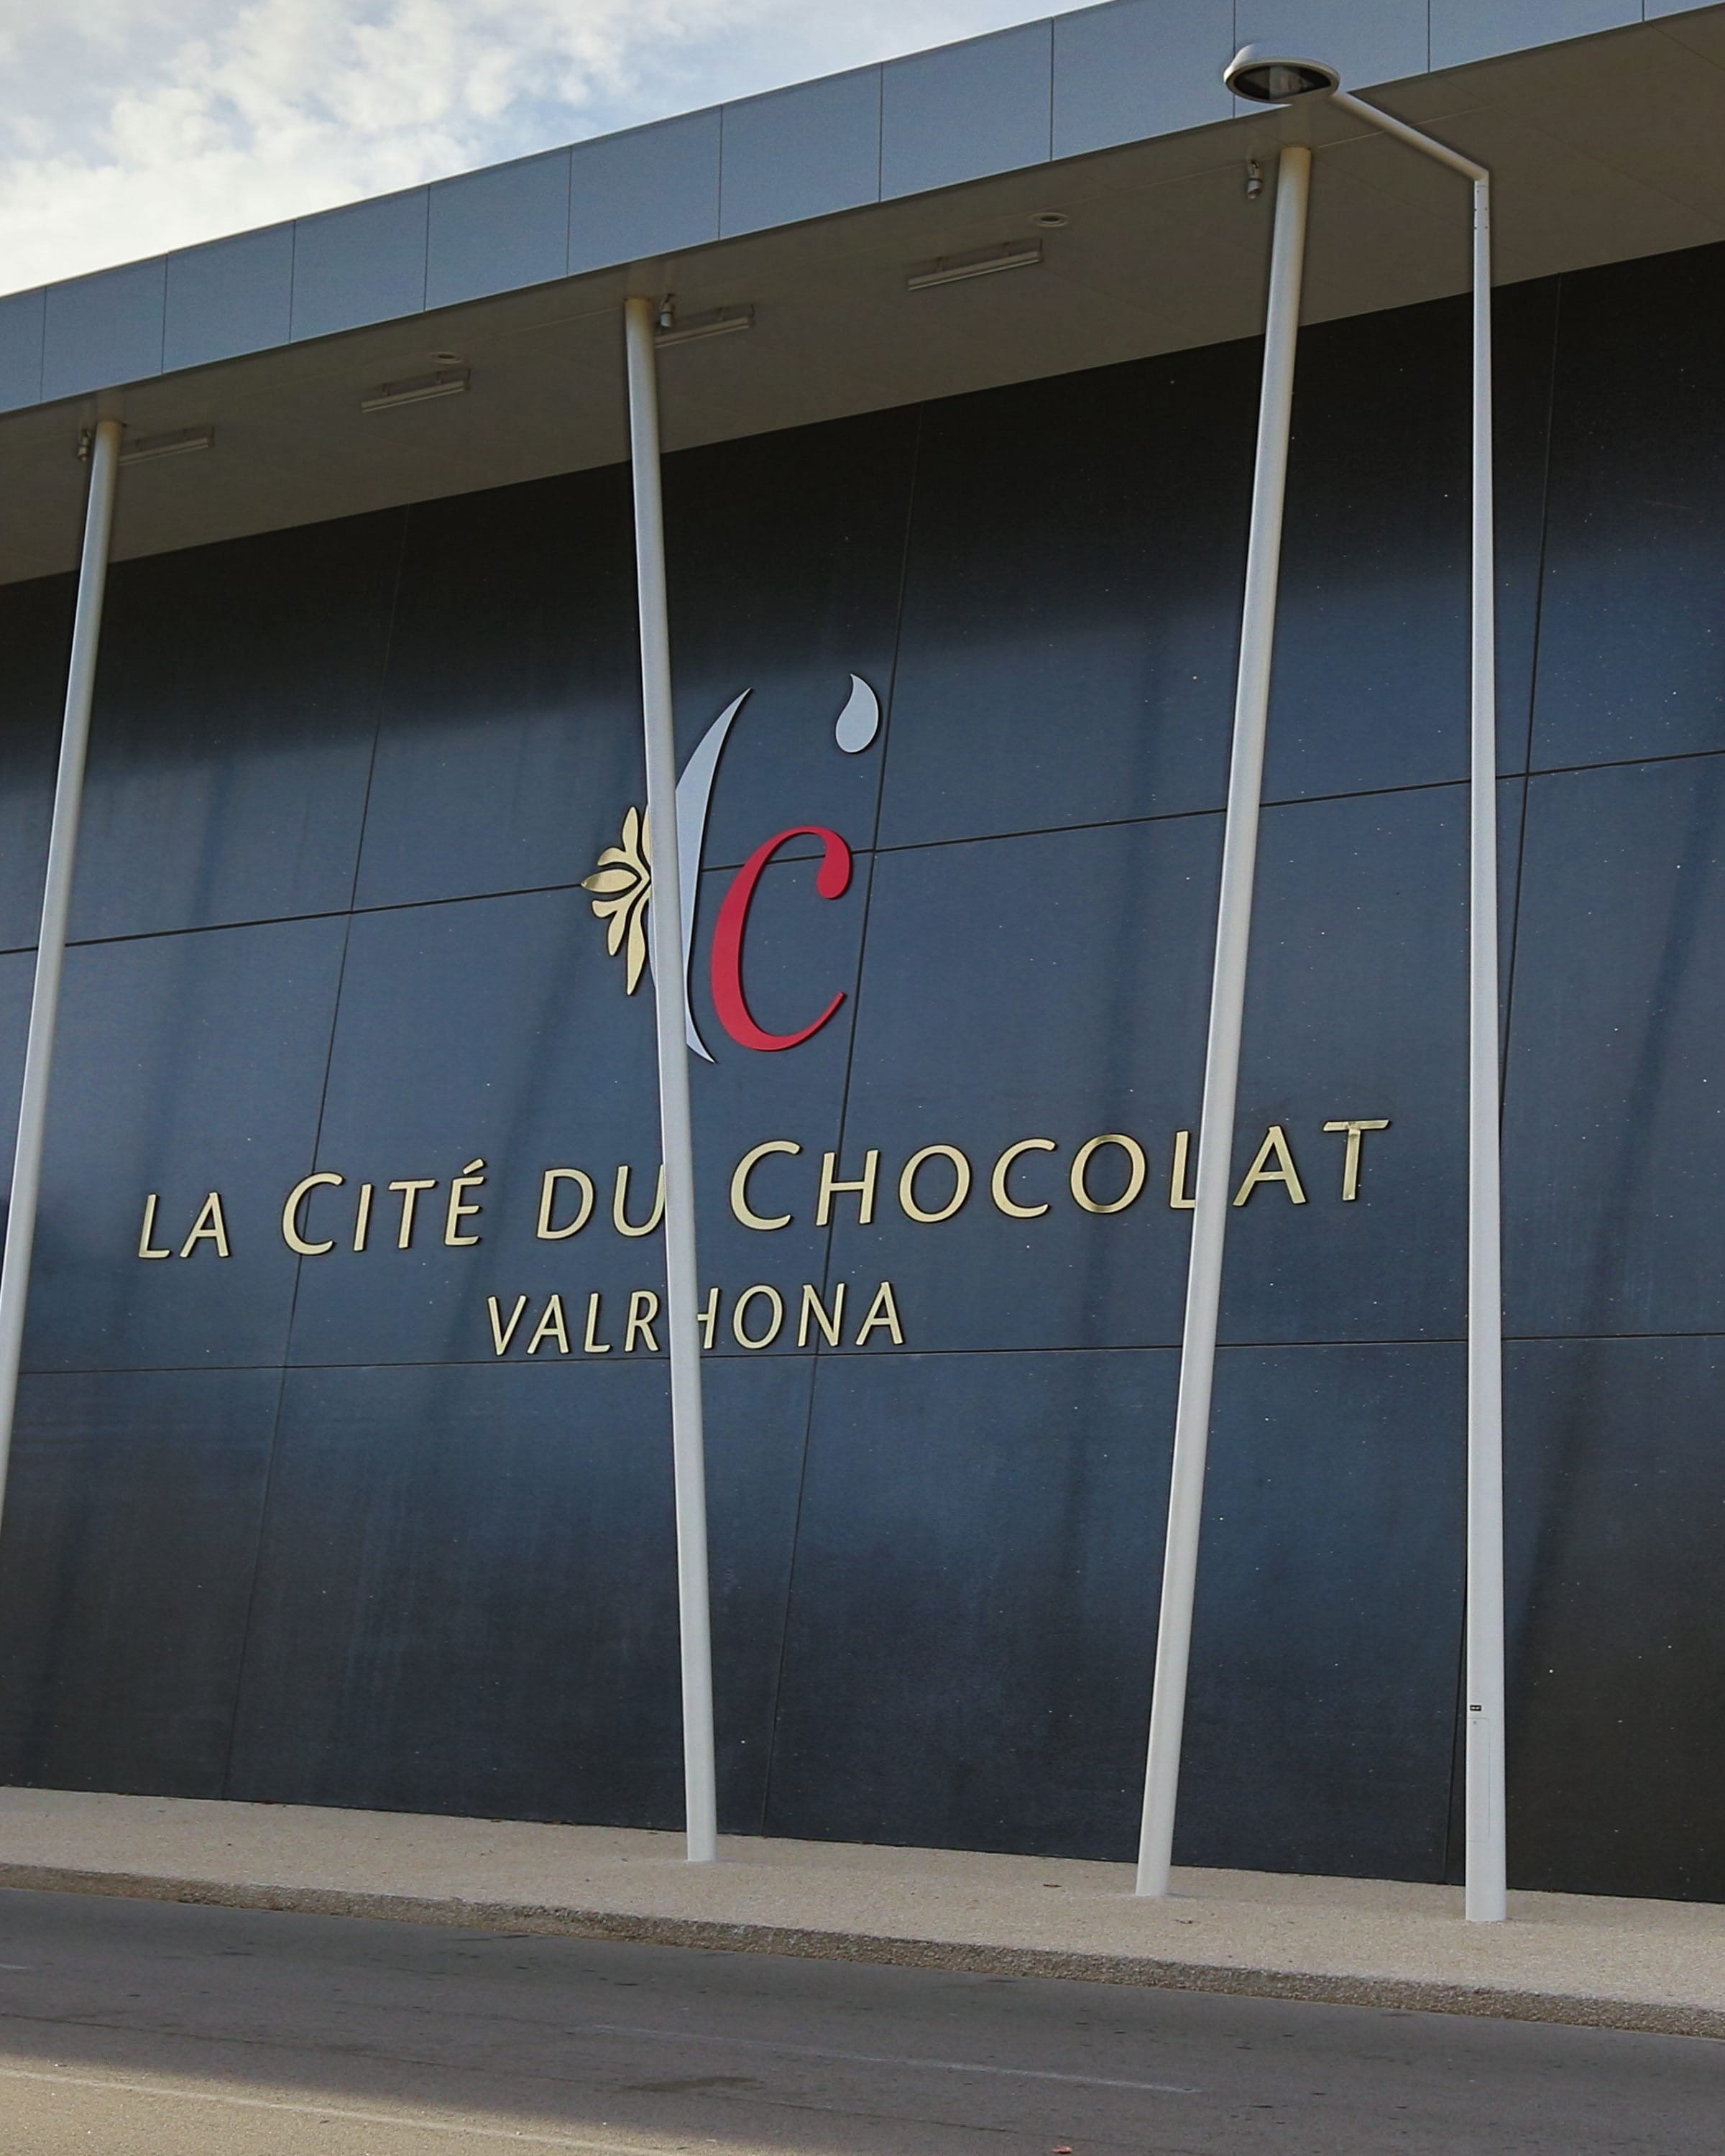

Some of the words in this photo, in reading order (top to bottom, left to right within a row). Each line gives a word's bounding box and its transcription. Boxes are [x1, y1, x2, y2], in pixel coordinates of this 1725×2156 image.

[138, 1191, 232, 1259] LA
[280, 1158, 487, 1256] CITÉ
[536, 1164, 666, 1240] DU
[729, 1118, 1390, 1231] CHOCOLAT
